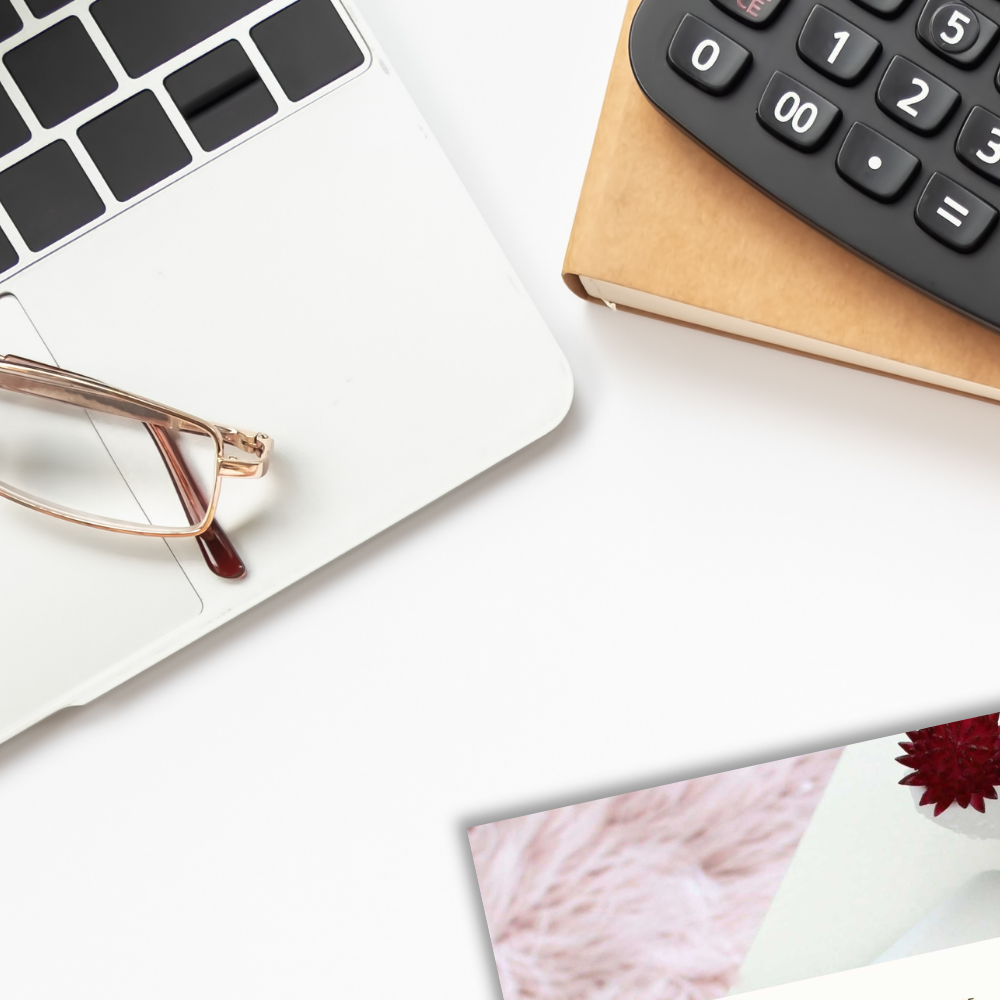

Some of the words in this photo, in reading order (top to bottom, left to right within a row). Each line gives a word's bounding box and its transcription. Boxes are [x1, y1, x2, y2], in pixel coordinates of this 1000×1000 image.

[939, 9, 971, 45] 5
[691, 38, 721, 72] 0
[826, 30, 851, 65] 1
[774, 91, 819, 134] 00
[896, 77, 930, 118] 2
